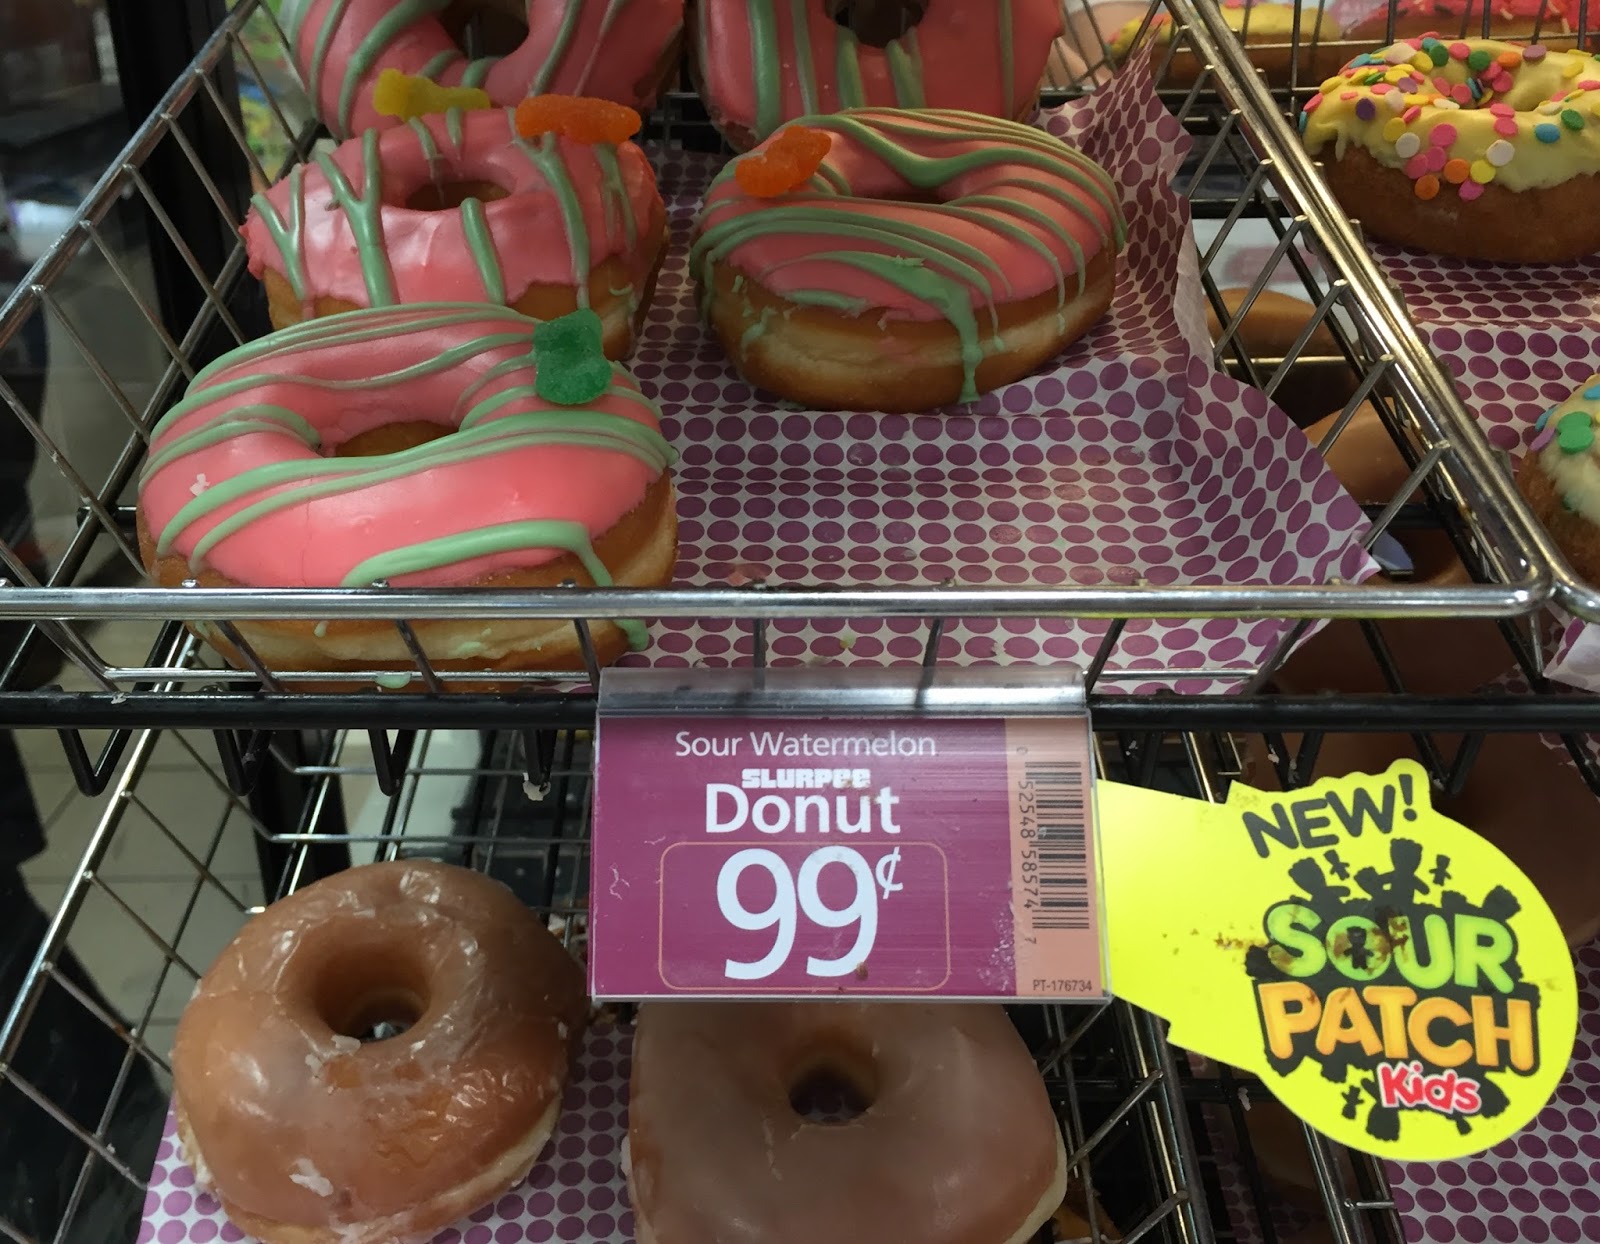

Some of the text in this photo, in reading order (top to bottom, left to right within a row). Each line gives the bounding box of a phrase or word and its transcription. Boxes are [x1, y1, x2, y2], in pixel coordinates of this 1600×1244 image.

[675, 730, 936, 757] Sour Watermelon
[706, 783, 901, 834] Donut
[1018, 781, 1036, 839] 52548
[1242, 774, 1418, 858] NEW!
[1021, 850, 1039, 909] 58574
[1266, 903, 1515, 994] SOUR
[1032, 979, 1093, 992] PT-176734
[1257, 982, 1535, 1072] PATCH
[1380, 1063, 1480, 1112] Kids
